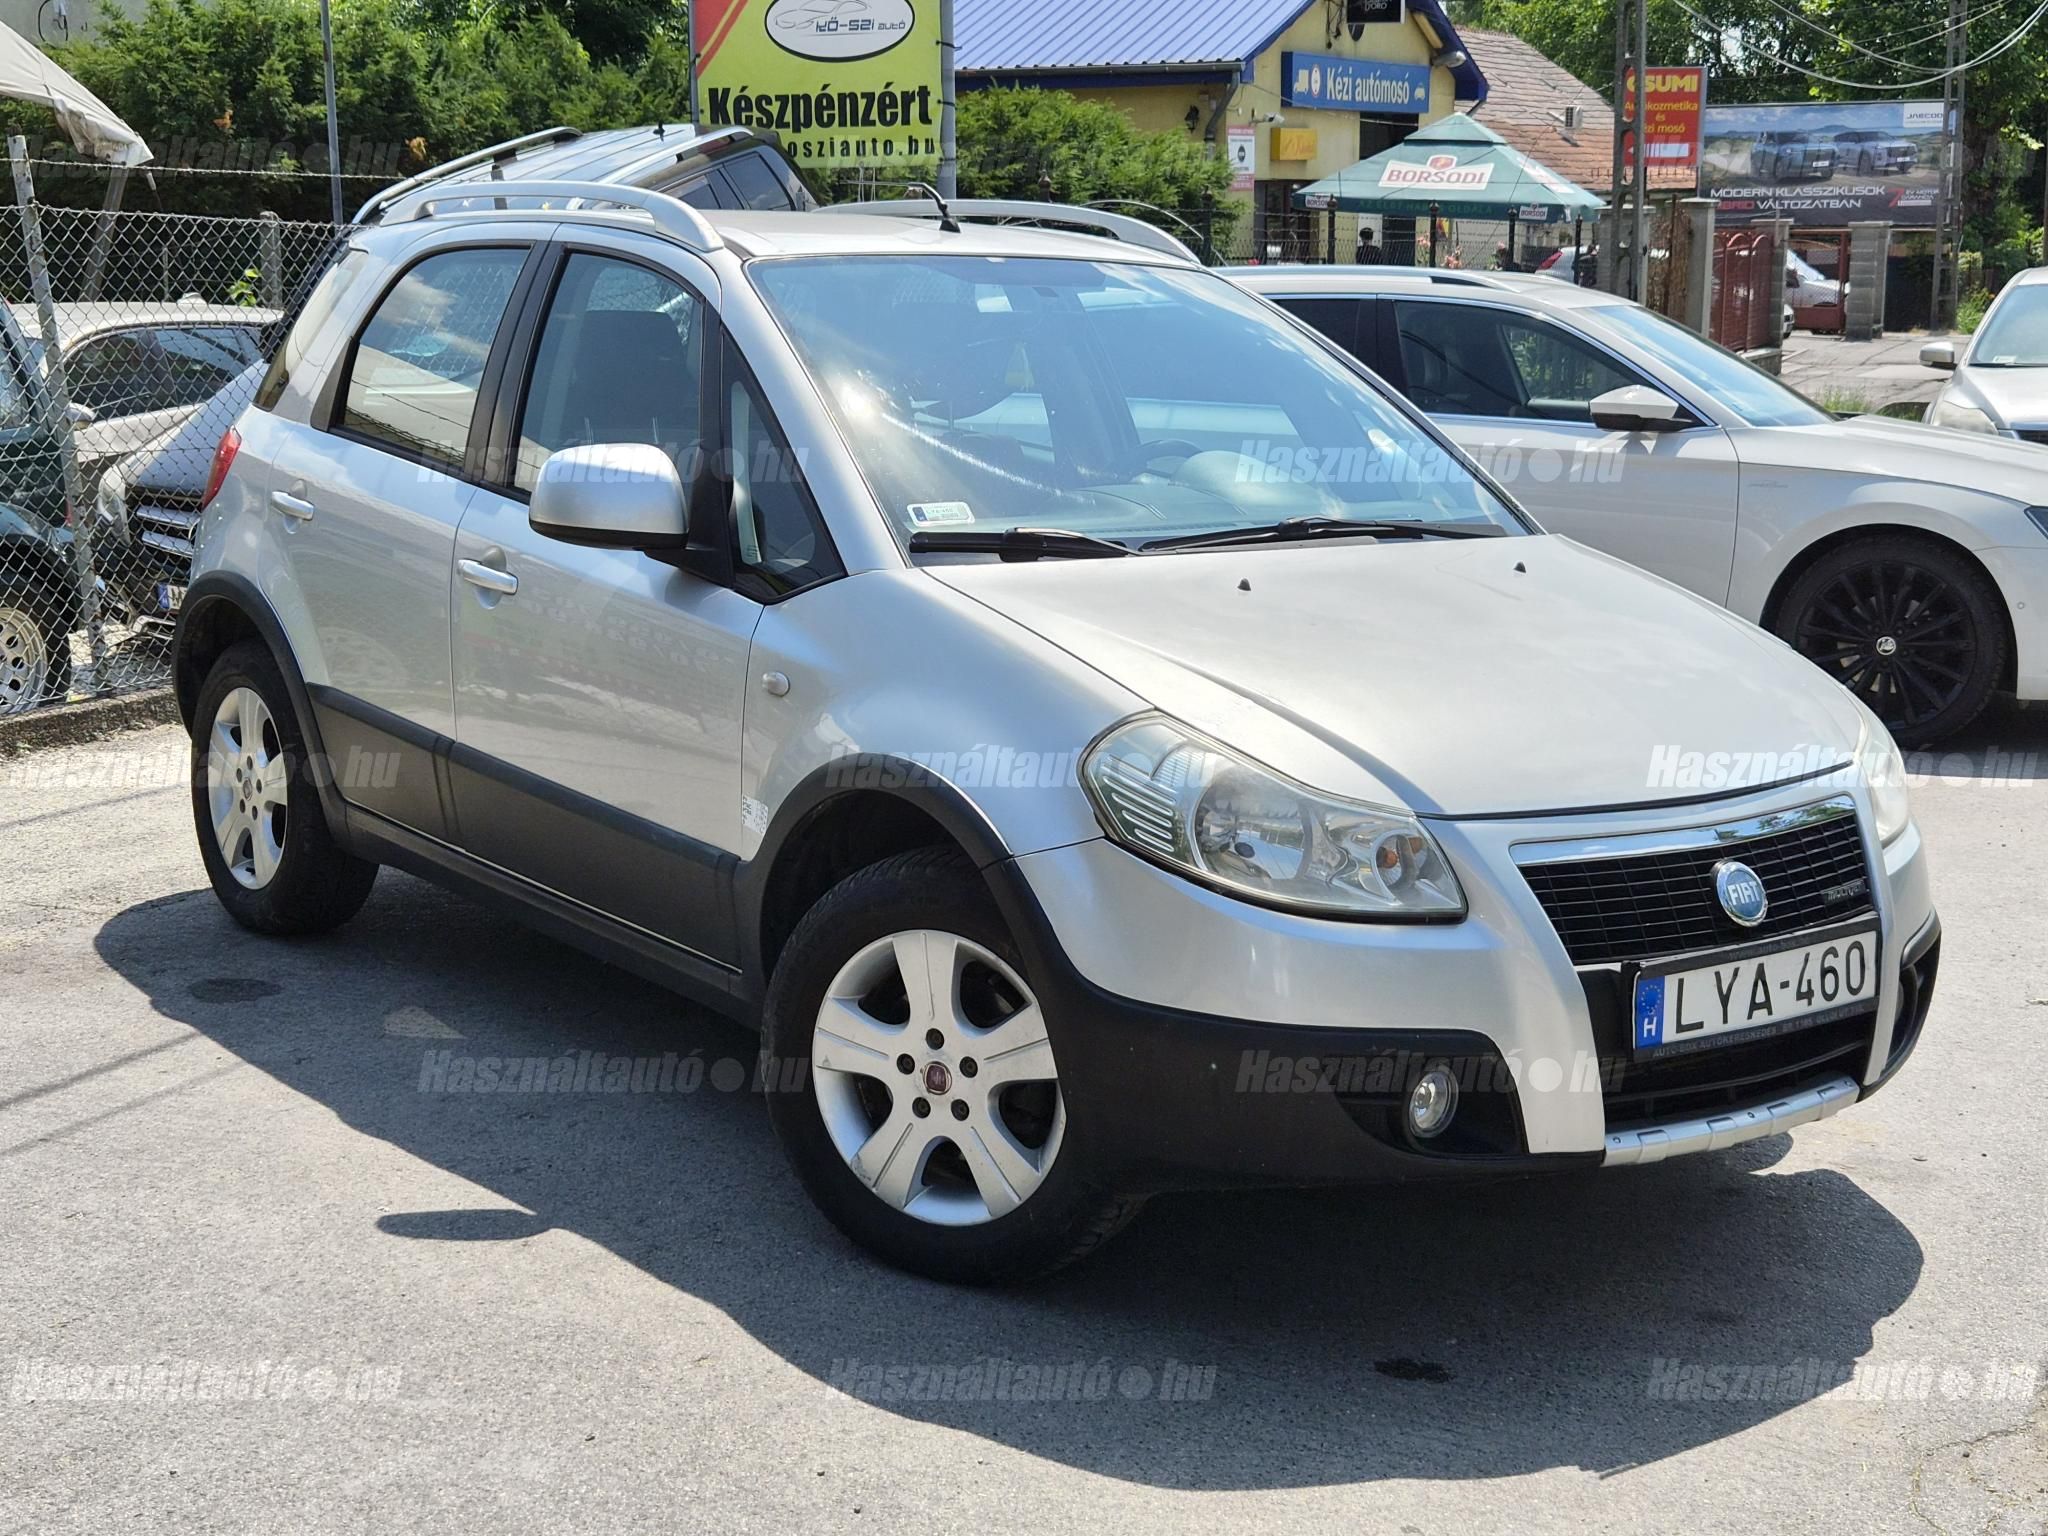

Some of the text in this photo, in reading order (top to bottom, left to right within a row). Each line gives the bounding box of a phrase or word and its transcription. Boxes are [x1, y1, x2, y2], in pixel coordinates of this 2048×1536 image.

[1327, 65, 1353, 101] Kézi
[708, 82, 933, 133] Készpénzért
[1657, 122, 1686, 133] mosó
[1386, 169, 1485, 185] BORSODI
[1710, 185, 1885, 198] MODERN KLASSZIKUSOK
[1756, 198, 1862, 209] VÁLTOZATBAN
[1520, 209, 1546, 218] BORSODI
[1727, 881, 1760, 906] FIAT
[1675, 940, 1866, 1034] LYA-460
[1643, 1016, 1657, 1038] H
